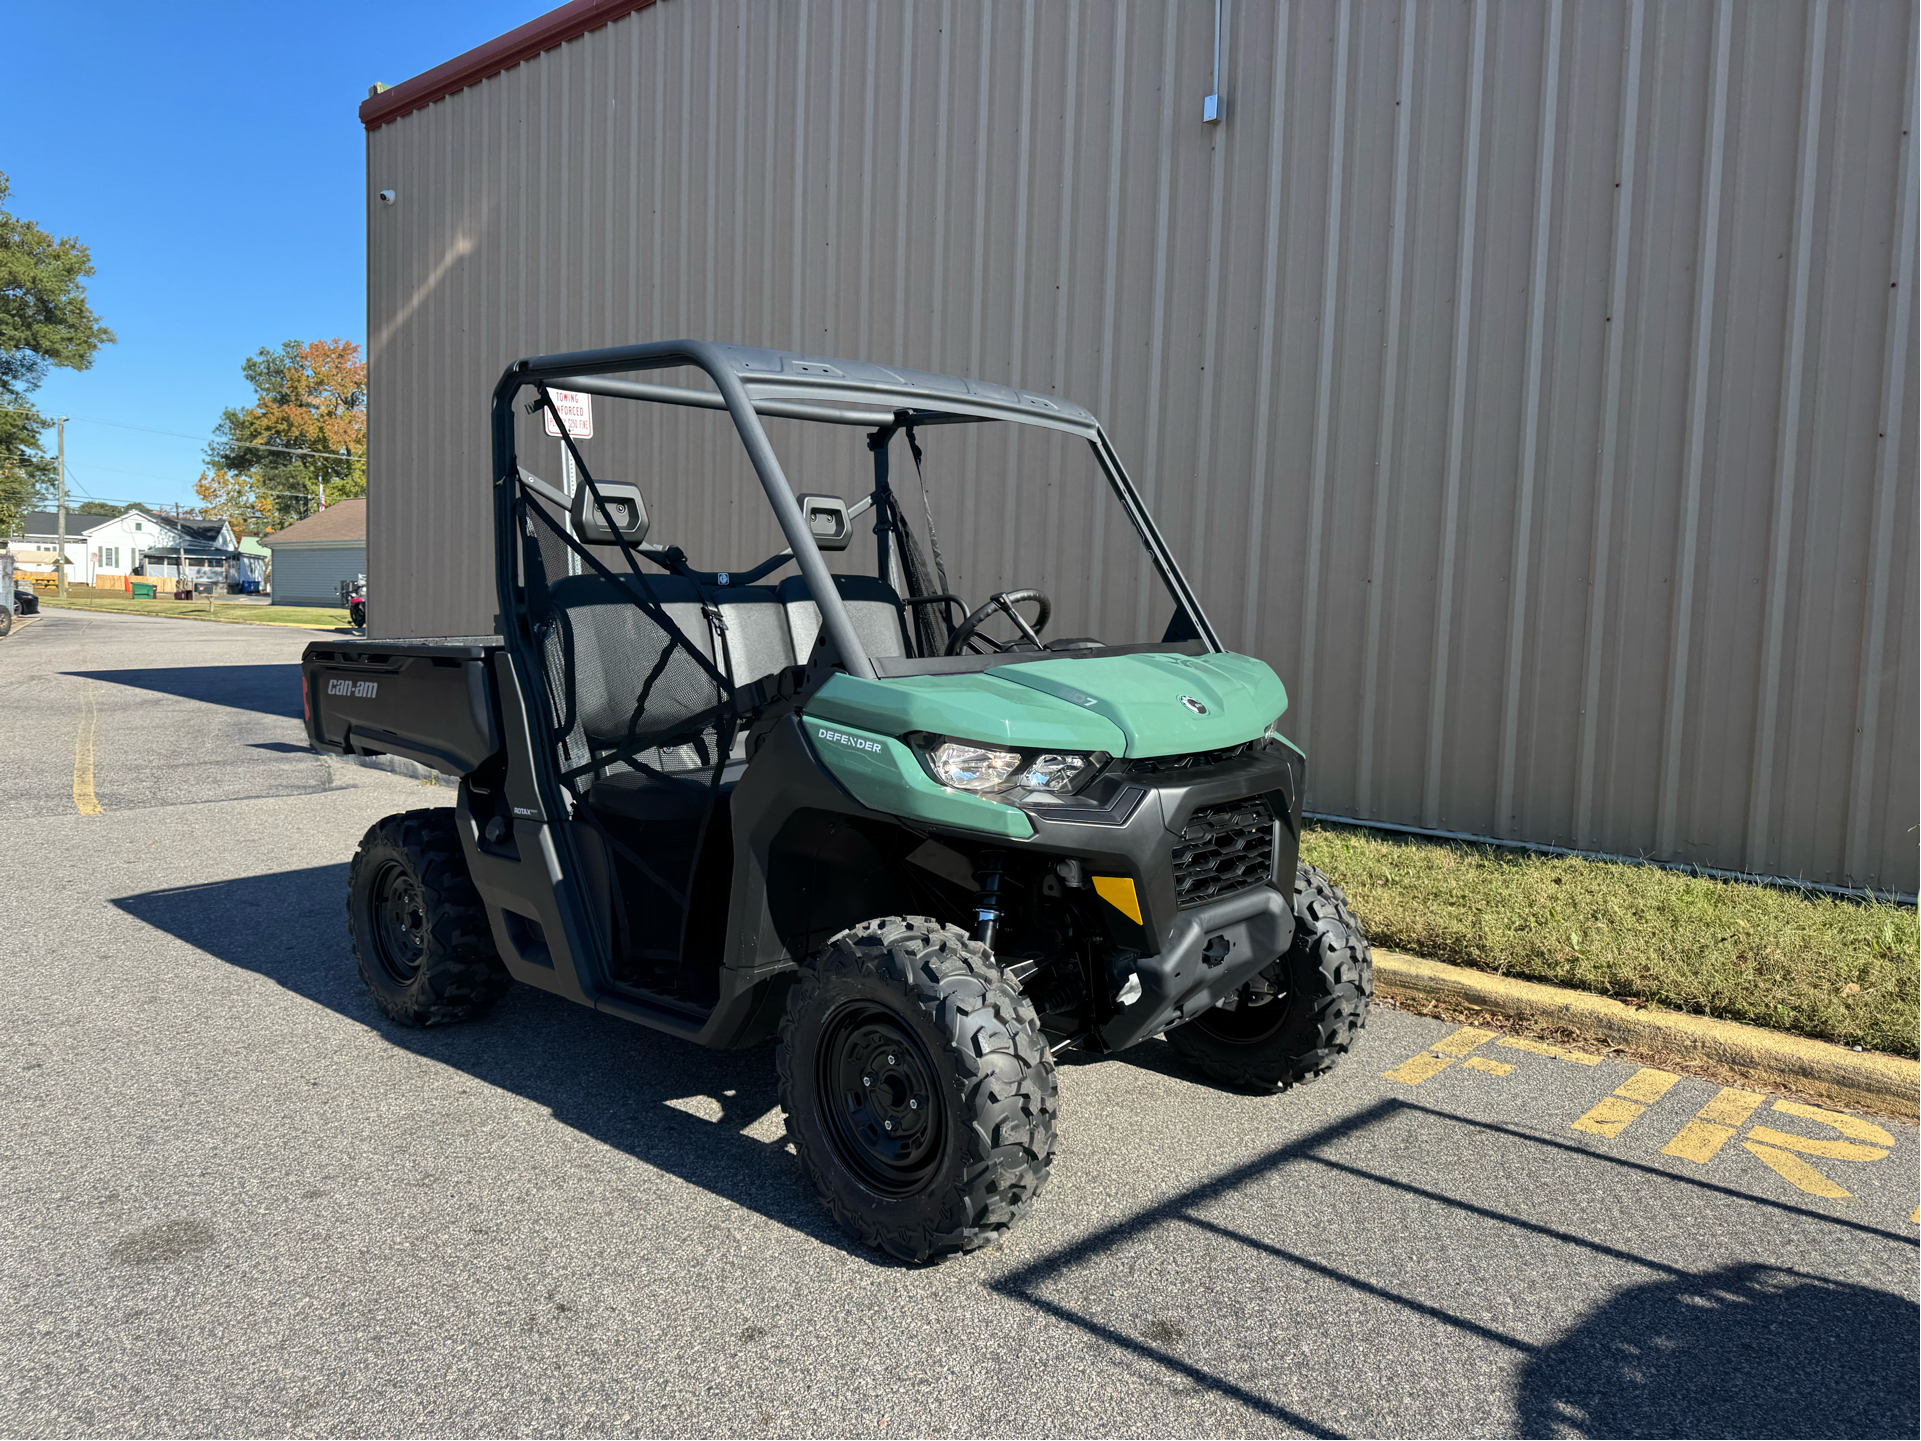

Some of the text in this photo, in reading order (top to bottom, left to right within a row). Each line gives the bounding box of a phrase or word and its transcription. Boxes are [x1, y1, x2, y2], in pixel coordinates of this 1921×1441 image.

[556, 392, 578, 403] TOWING
[556, 405, 584, 416] NFORCED
[327, 679, 378, 698] can-am
[818, 728, 882, 754] DEFENDER
[1380, 1026, 1921, 1225] FIR
